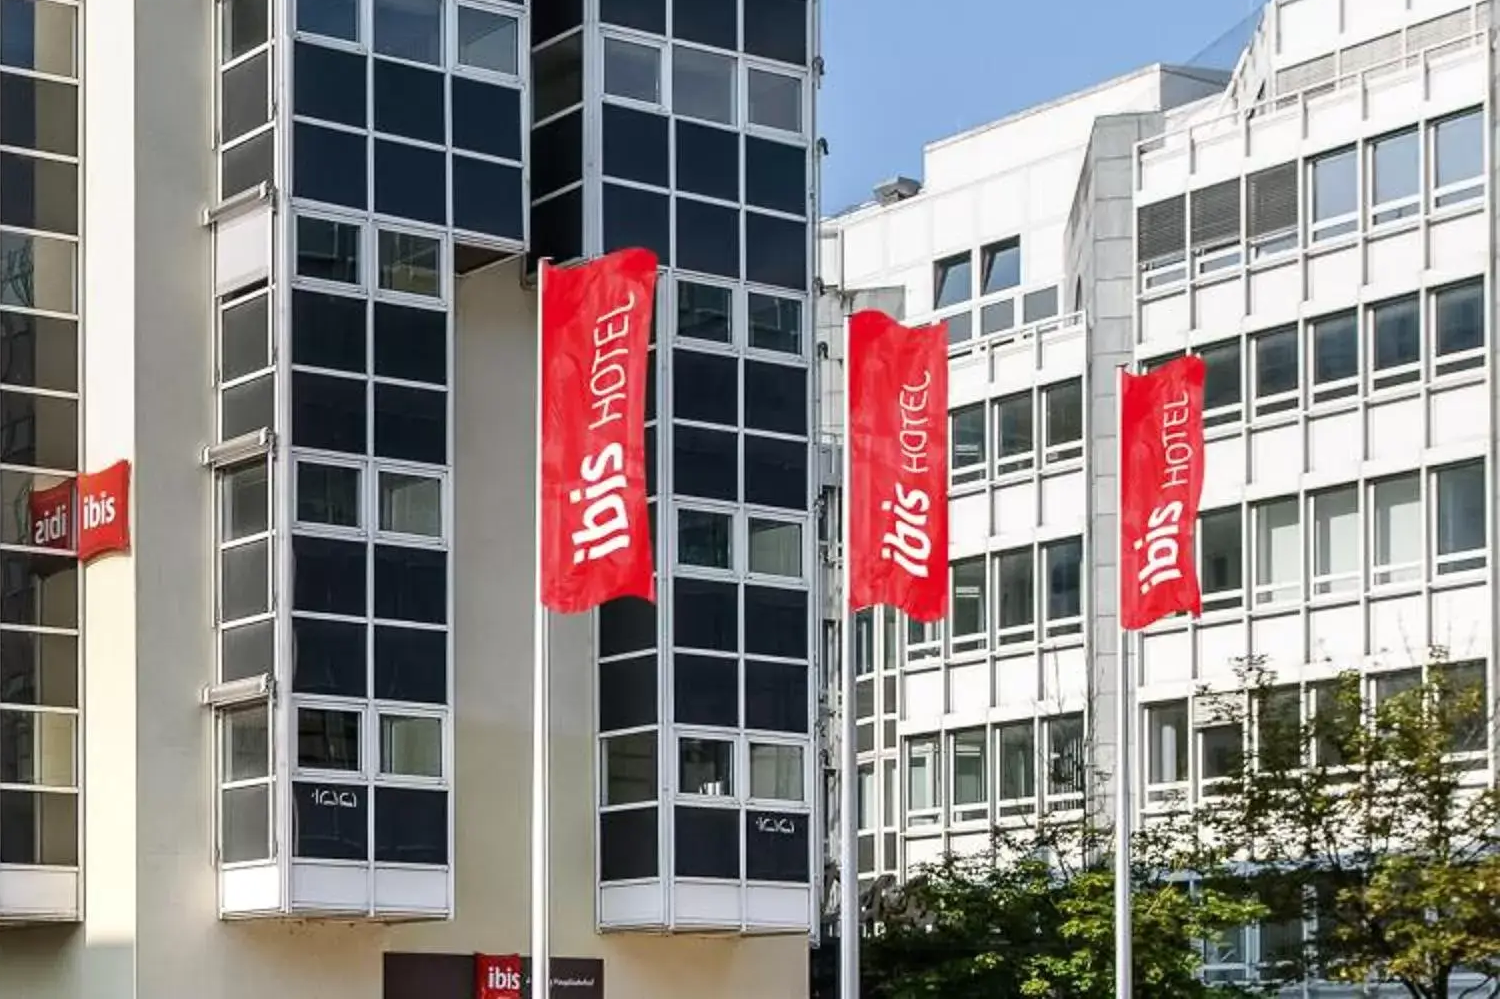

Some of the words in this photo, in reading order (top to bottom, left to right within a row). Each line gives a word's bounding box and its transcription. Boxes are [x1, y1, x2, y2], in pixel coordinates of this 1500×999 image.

[588, 290, 635, 431] HOTEL
[899, 369, 932, 475] HOTEL
[83, 491, 116, 530] ibis
[569, 441, 630, 566] ibis
[881, 482, 932, 578] ibis
[1133, 500, 1183, 596] ibis
[1161, 391, 1194, 490] HOTEL
[487, 966, 521, 990] ibis
